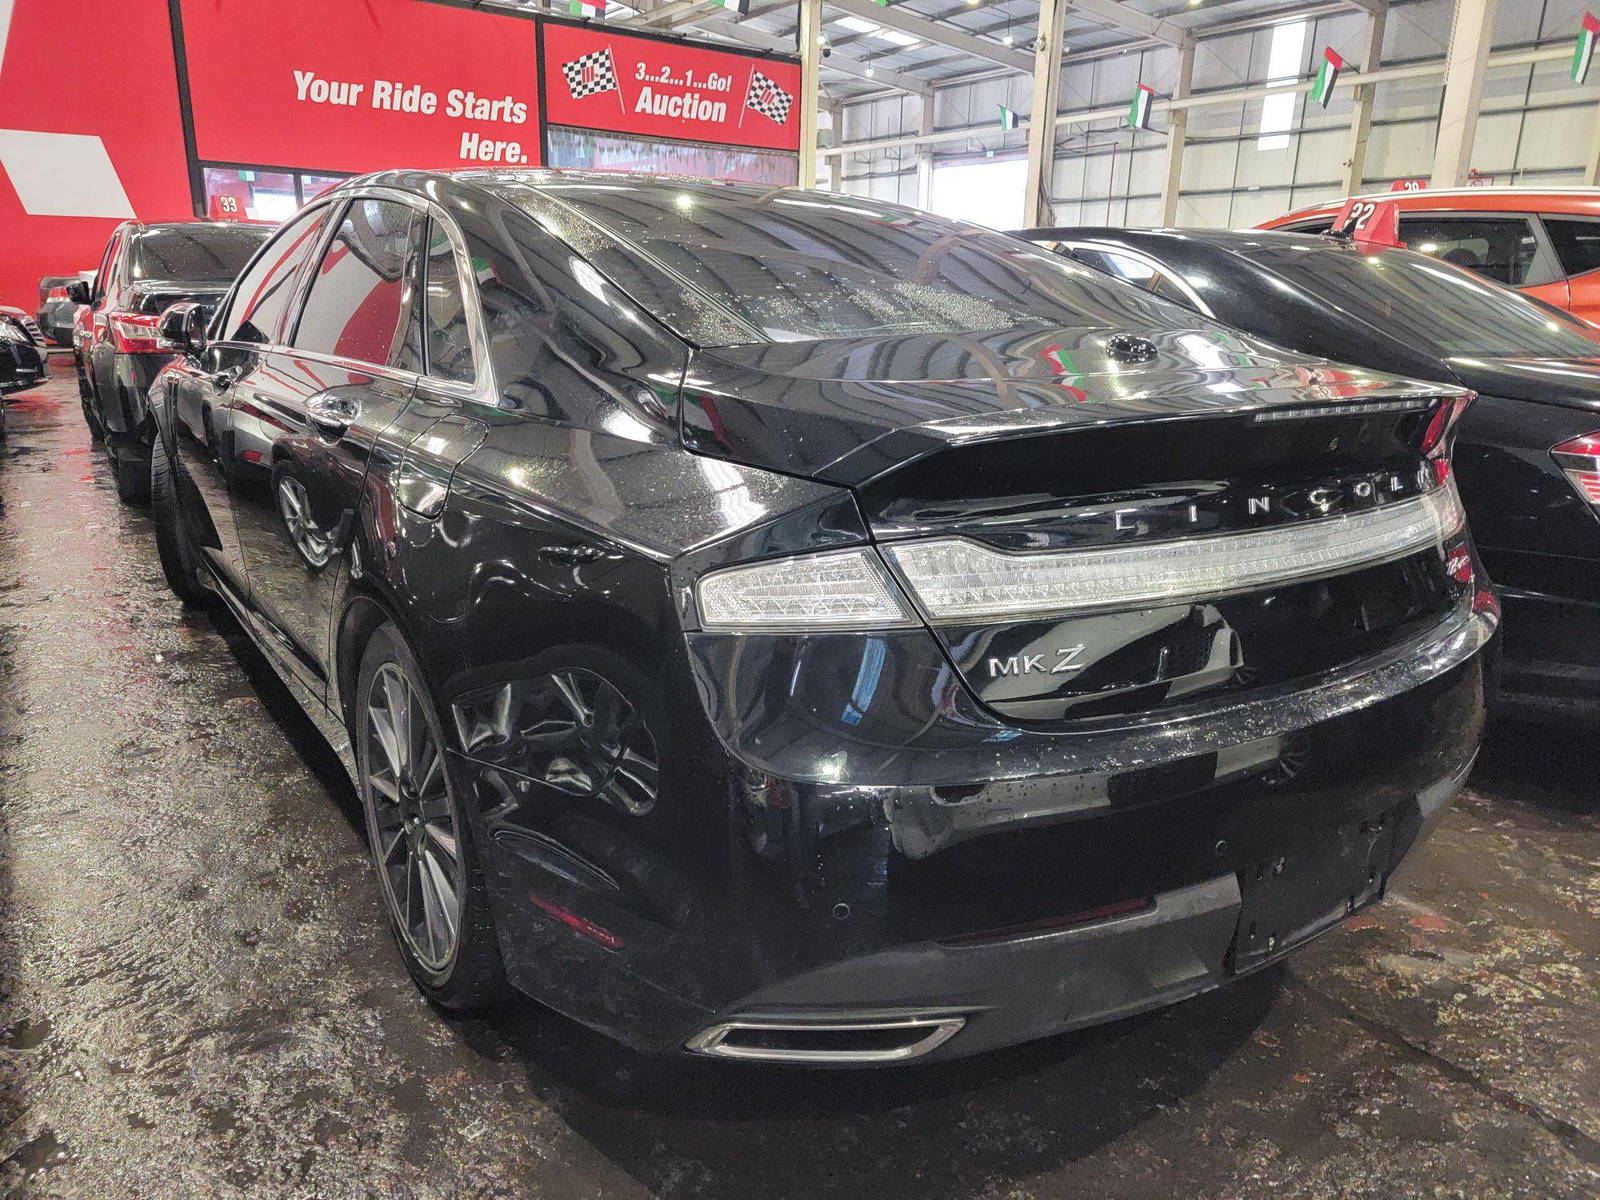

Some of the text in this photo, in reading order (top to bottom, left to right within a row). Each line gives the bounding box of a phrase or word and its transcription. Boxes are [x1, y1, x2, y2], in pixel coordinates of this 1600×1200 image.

[293, 70, 527, 124] Your Ride Starts
[635, 86, 727, 123] Auction
[460, 132, 527, 164] Here.
[220, 196, 238, 212] 33
[989, 643, 1085, 677] MKZ
